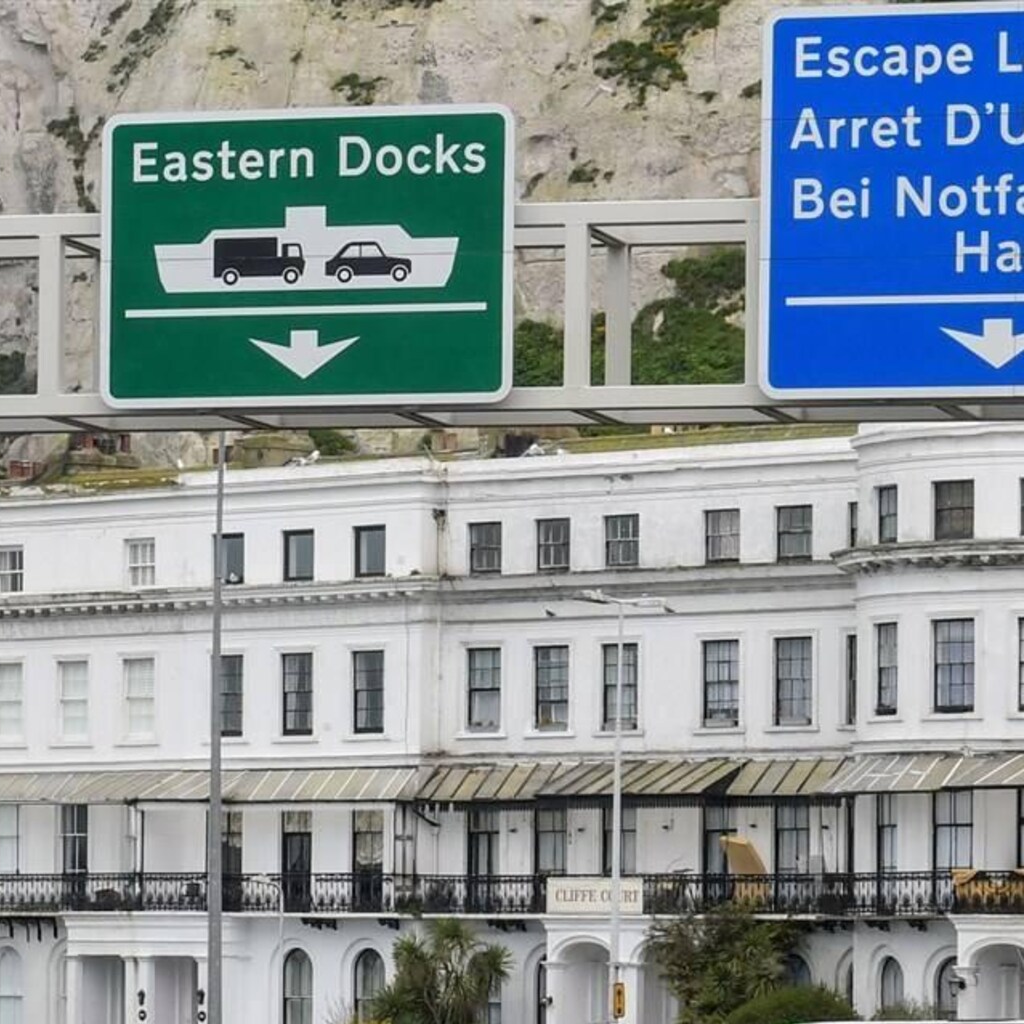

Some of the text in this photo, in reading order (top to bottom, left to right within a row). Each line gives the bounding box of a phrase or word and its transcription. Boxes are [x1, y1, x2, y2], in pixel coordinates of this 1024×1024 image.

[795, 36, 974, 84] Escape
[790, 104, 922, 150] Arret
[132, 133, 487, 183] Eastern Docks
[793, 177, 871, 220] Bei
[555, 889, 596, 903] CLIFFE
